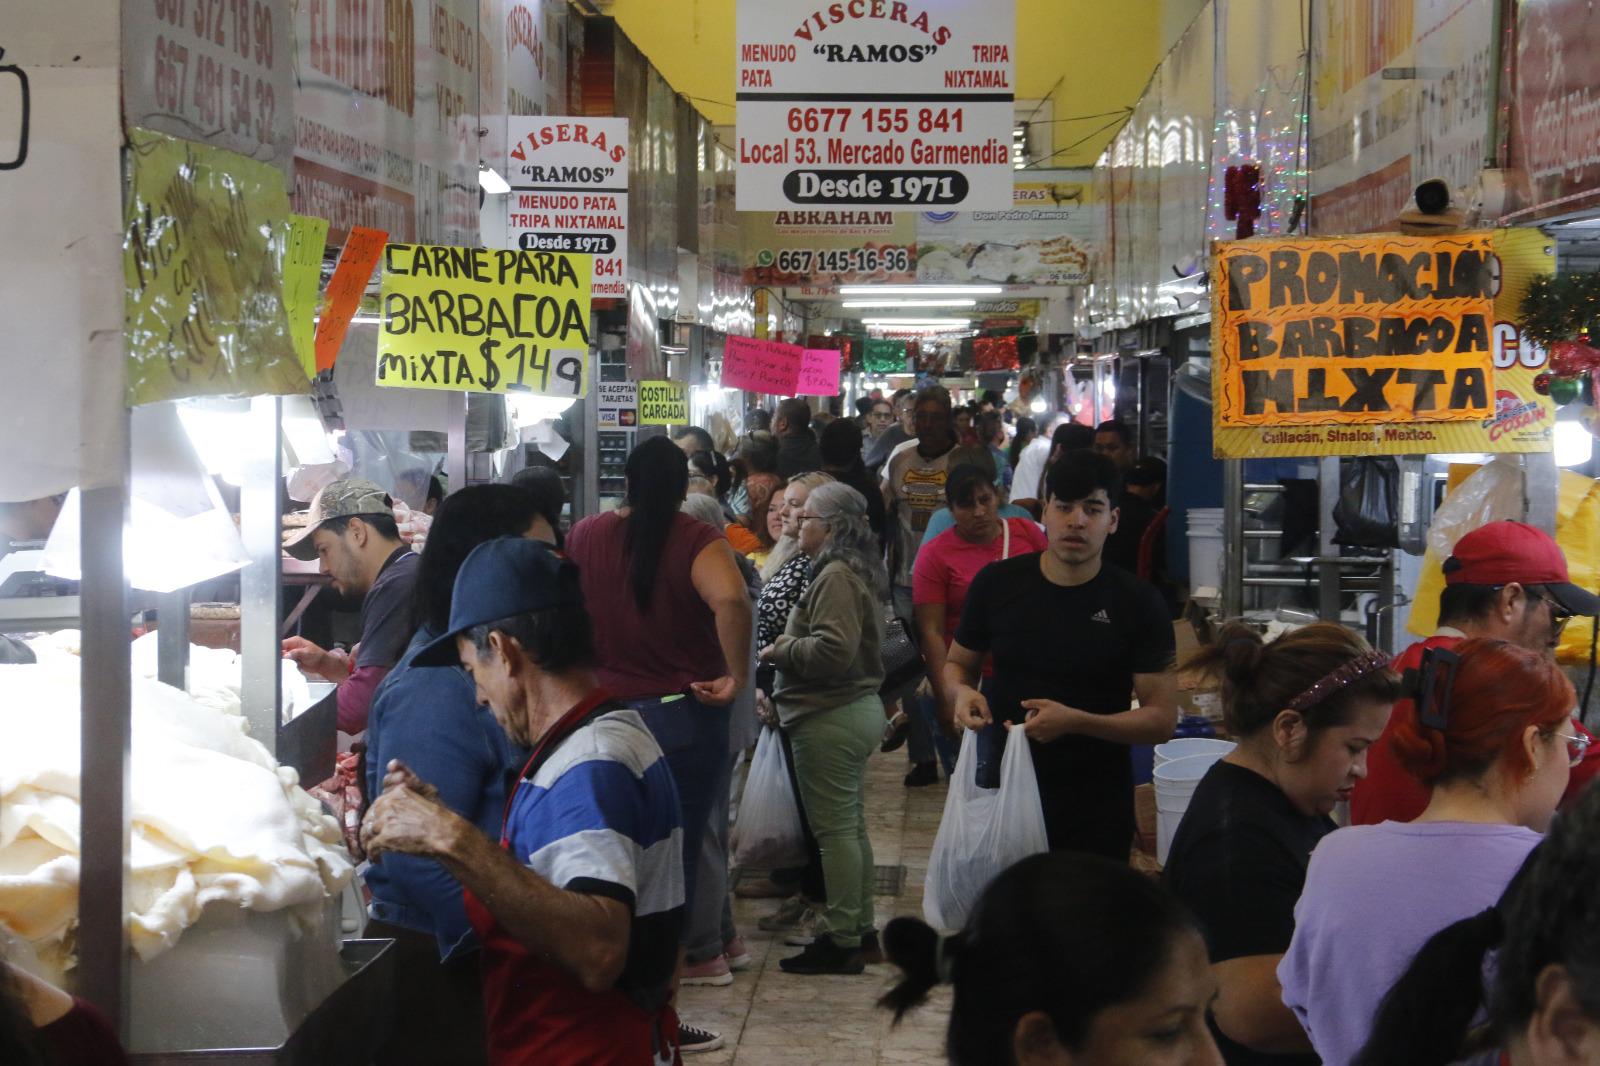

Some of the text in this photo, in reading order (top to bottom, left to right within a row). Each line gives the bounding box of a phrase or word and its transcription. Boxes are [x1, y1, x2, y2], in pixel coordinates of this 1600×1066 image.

[794, 0, 952, 46] VISCERAS
[742, 44, 796, 62] MENUDO
[972, 44, 1009, 62] TRIPA
[155, 34, 189, 115] 667
[742, 70, 772, 87] PATA
[944, 70, 1008, 88] NIXTAMAL
[787, 108, 964, 133] 6677 155 841
[510, 124, 626, 163] VISERAS
[740, 138, 1008, 165] Local 53. Mercado Garmendia
[798, 173, 954, 201] Desde 1971
[519, 195, 617, 210] MENUDO PATA
[510, 214, 625, 230] TRIPA NIXTAMAL
[775, 211, 894, 225] ABRAHAM
[973, 210, 1069, 221] Don Pedro Ramos
[526, 234, 609, 252] Desde 1971
[386, 244, 579, 289] CARNE PARA
[595, 258, 623, 277] 841
[779, 251, 907, 271] 667 145-16-36
[385, 289, 590, 345] BARBACOA
[1238, 314, 1489, 361] BARBACOA
[608, 385, 637, 393] ACEPTAN
[641, 386, 686, 402] COSTILLA
[1241, 367, 1488, 415] MIXTA
[601, 394, 634, 403] TARJETAS
[601, 413, 616, 421] VISA
[642, 403, 686, 420] CARGADA
